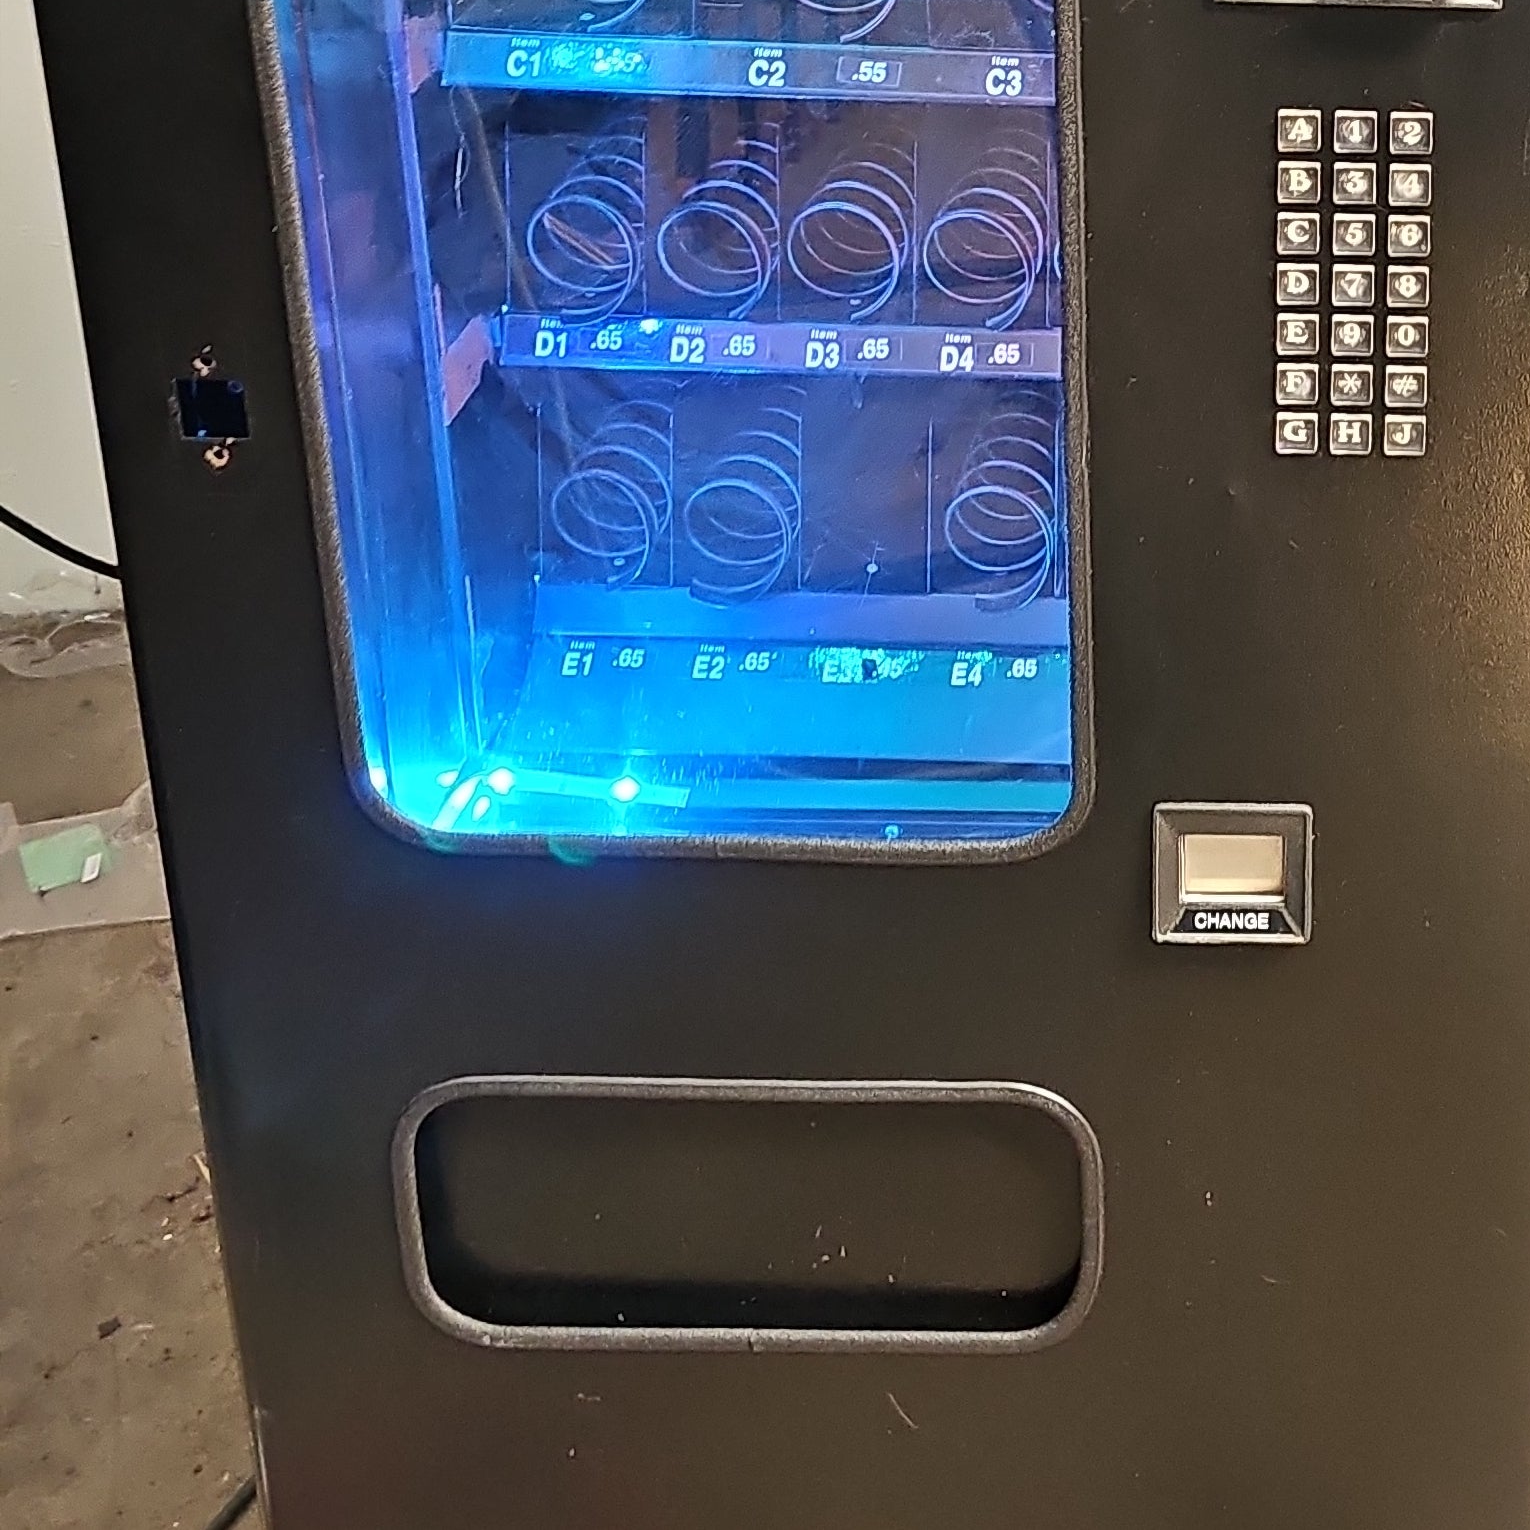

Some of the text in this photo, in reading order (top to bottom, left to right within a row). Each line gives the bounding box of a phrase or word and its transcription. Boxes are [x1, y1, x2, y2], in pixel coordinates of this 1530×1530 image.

[506, 49, 542, 78] C1
[748, 59, 887, 87] C2 .55
[991, 56, 1019, 67] Item
[985, 68, 1022, 96] C3
[1288, 117, 1422, 145] A 1 2
[1288, 169, 1421, 196] B 3 4
[1287, 220, 1421, 246] C 5 6
[1287, 271, 1417, 298] D 7 8
[540, 319, 564, 329] Ite
[676, 324, 703, 335] Item
[810, 328, 838, 340] Item
[1286, 321, 1308, 344] E
[1343, 322, 1361, 347] 9
[534, 330, 623, 357] D1 .65
[669, 335, 755, 364] D2 .65
[945, 333, 972, 343] Item
[805, 338, 889, 369] D3 .65
[940, 344, 1021, 372] D4 .65
[1286, 371, 1307, 393] F
[1283, 420, 1412, 445] G H J
[570, 640, 595, 650] Item
[700, 644, 725, 653] Item
[561, 648, 645, 676] E1 .65
[691, 652, 770, 679] E2 .65
[951, 658, 1037, 687] E4 .65
[1194, 912, 1269, 930] CHANGE
